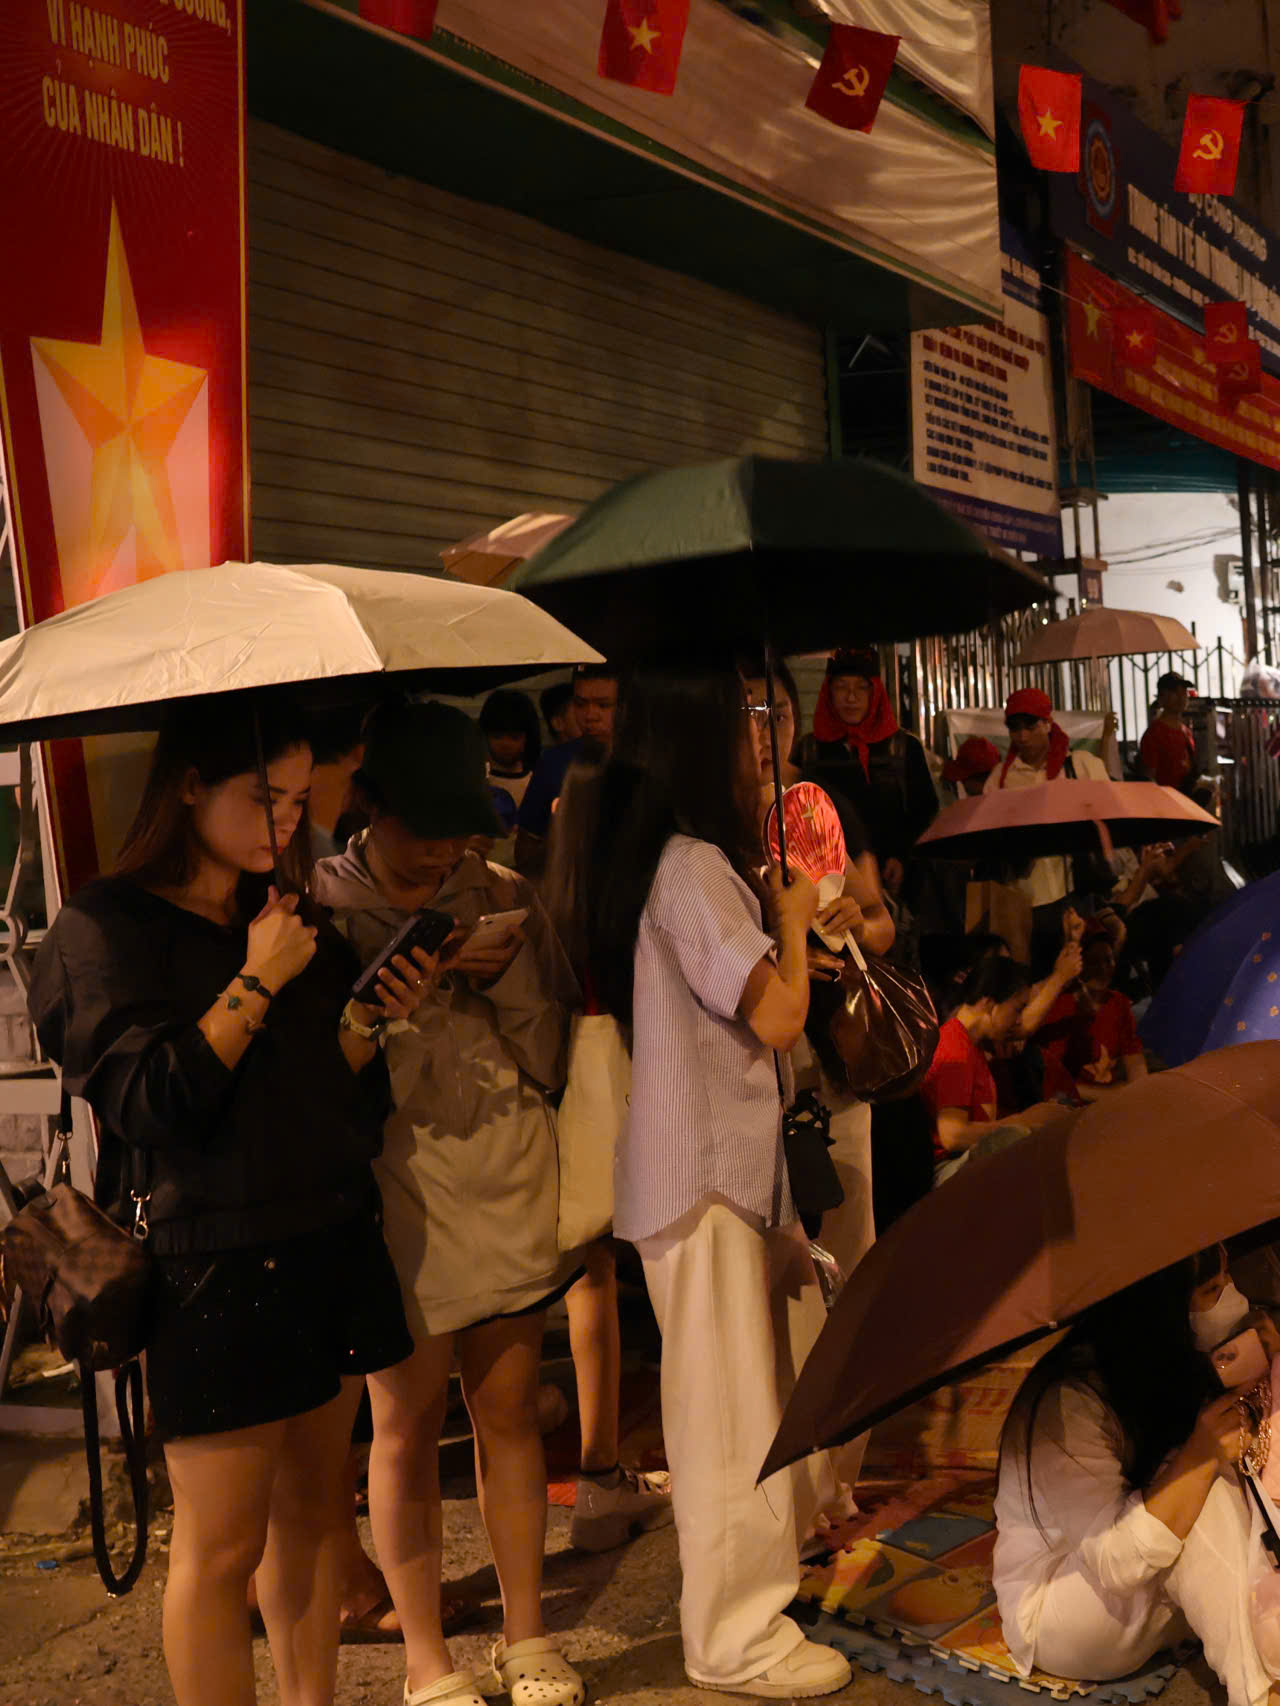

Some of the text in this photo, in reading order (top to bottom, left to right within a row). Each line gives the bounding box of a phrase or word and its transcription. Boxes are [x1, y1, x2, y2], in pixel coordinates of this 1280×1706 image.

[123, 21, 169, 84] PHÚC
[42, 58, 81, 136] CỦA
[84, 88, 135, 152] NHÂN
